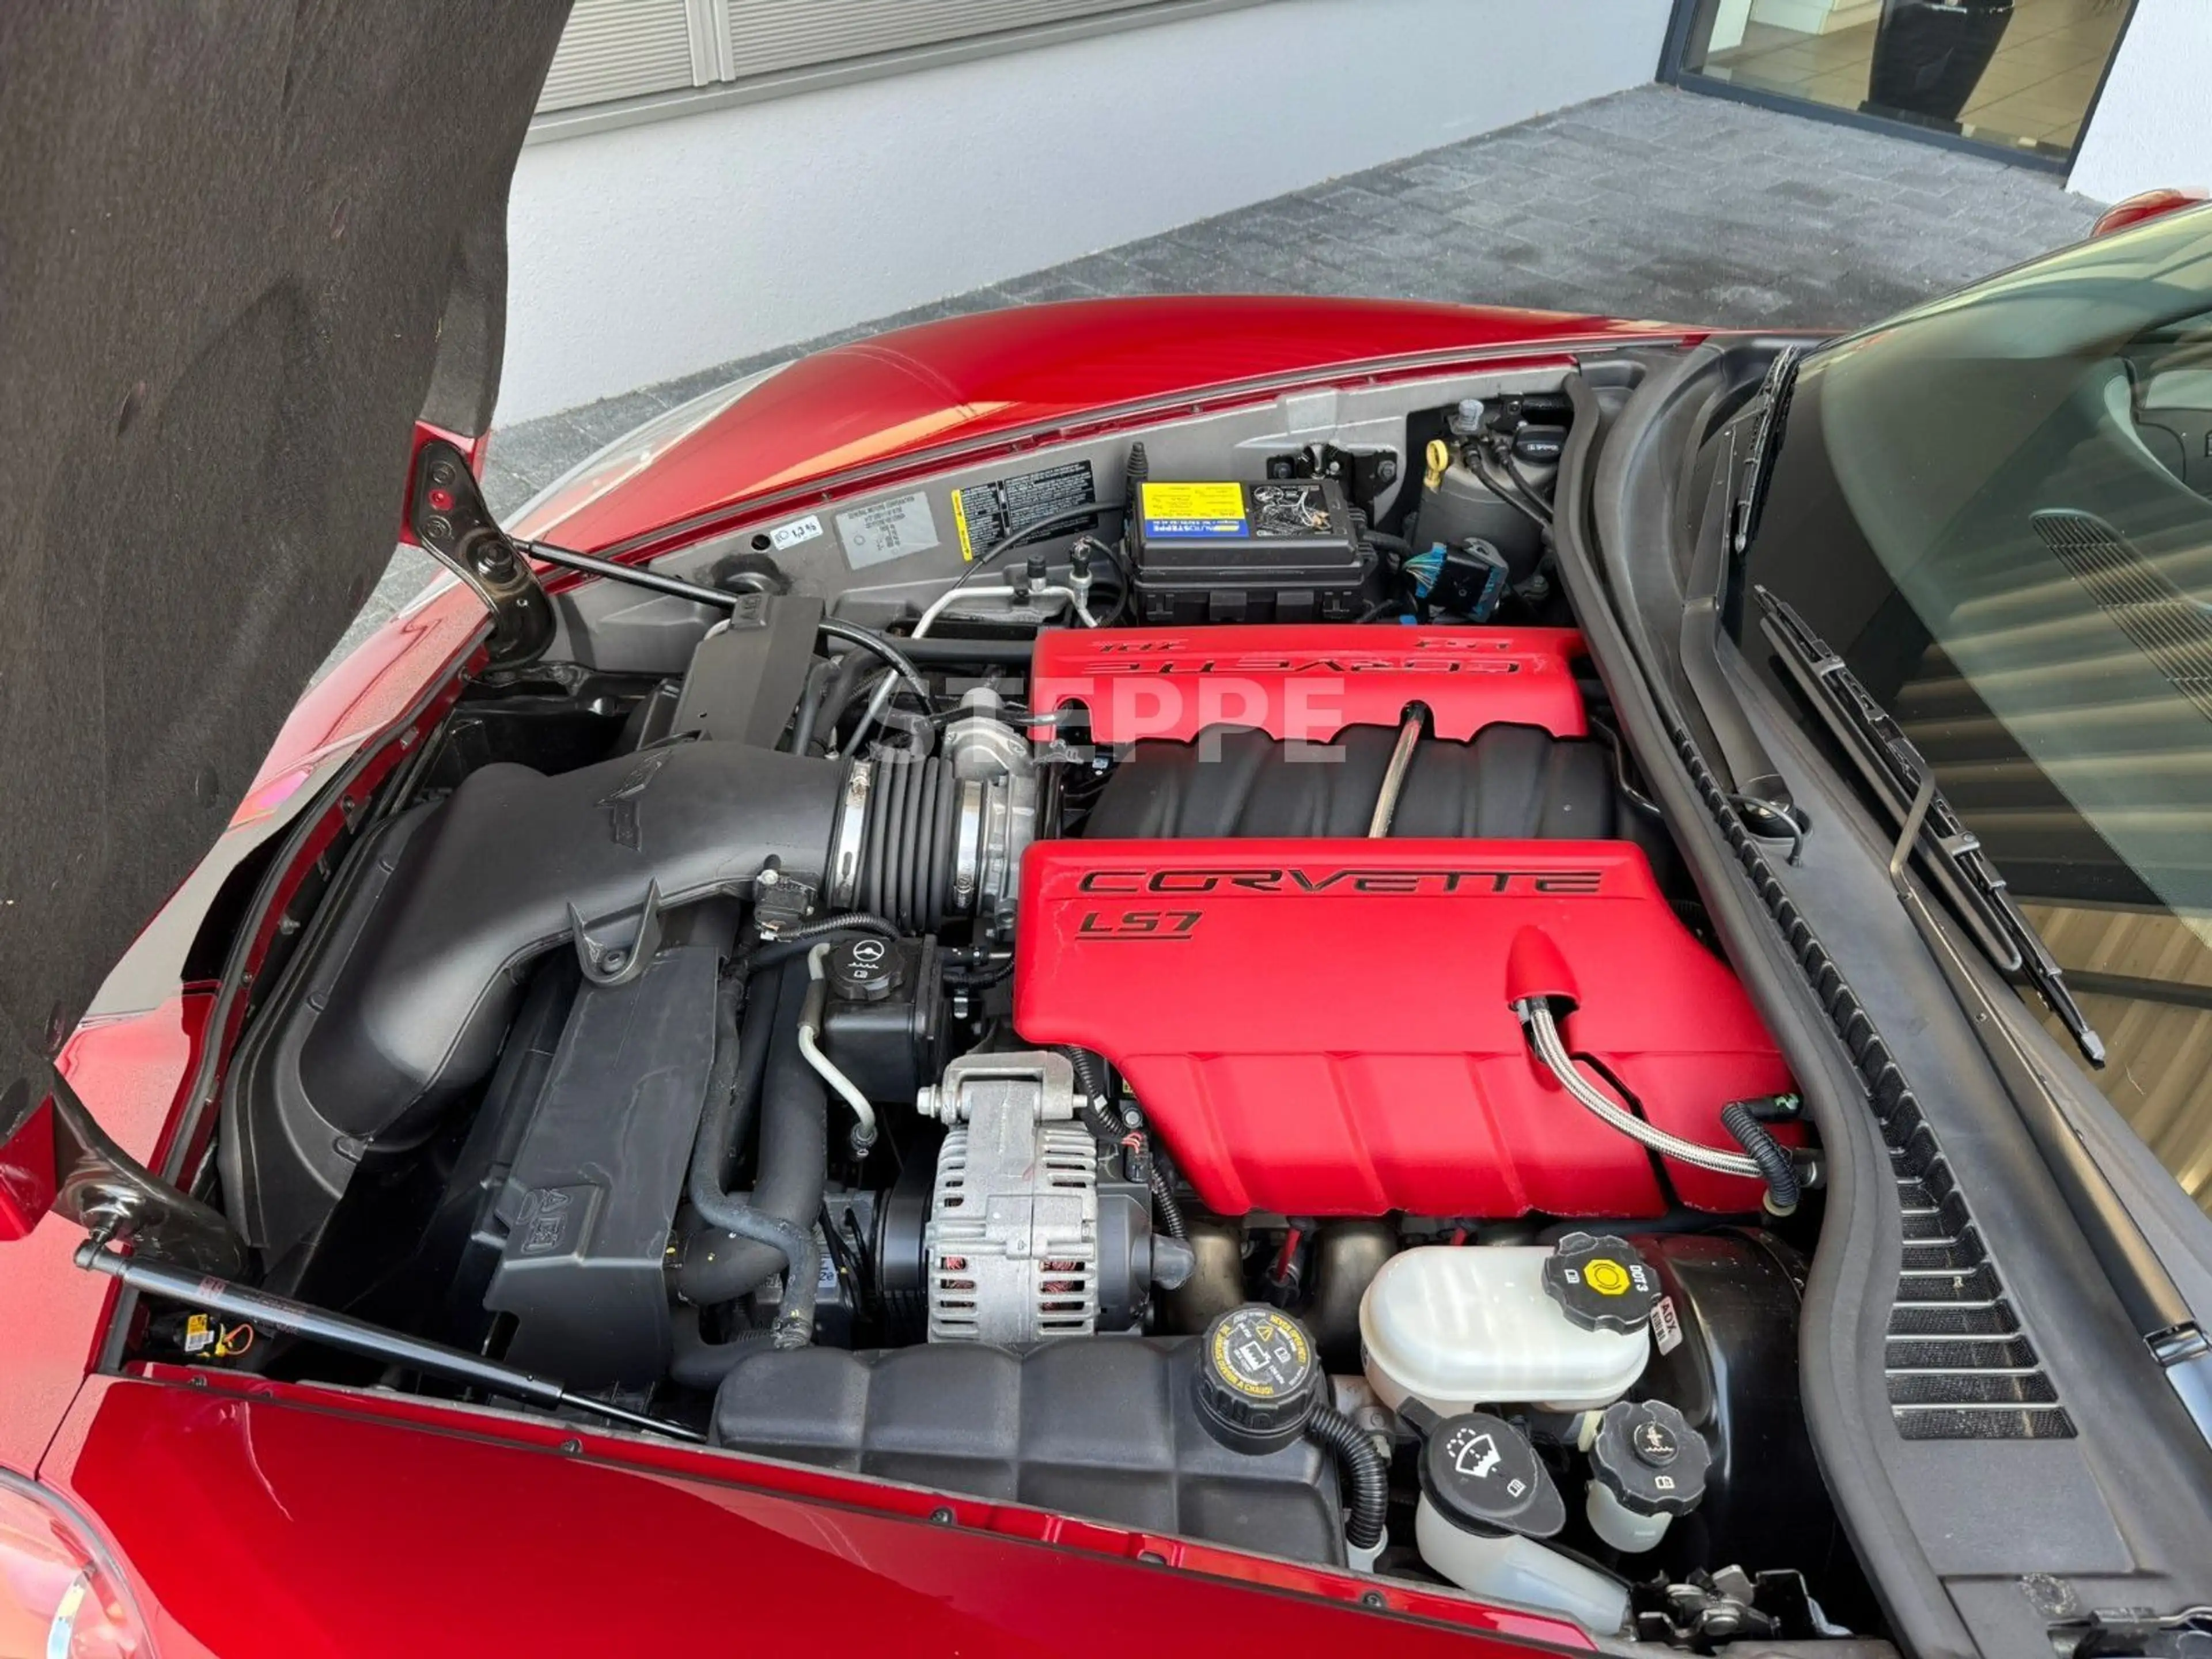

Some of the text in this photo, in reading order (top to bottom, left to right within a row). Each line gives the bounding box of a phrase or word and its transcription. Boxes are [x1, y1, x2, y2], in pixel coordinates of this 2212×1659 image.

[1078, 869, 1601, 893] CORVETTE
[1080, 910, 1203, 932] LS7
[1661, 1303, 1676, 1334] ADX
